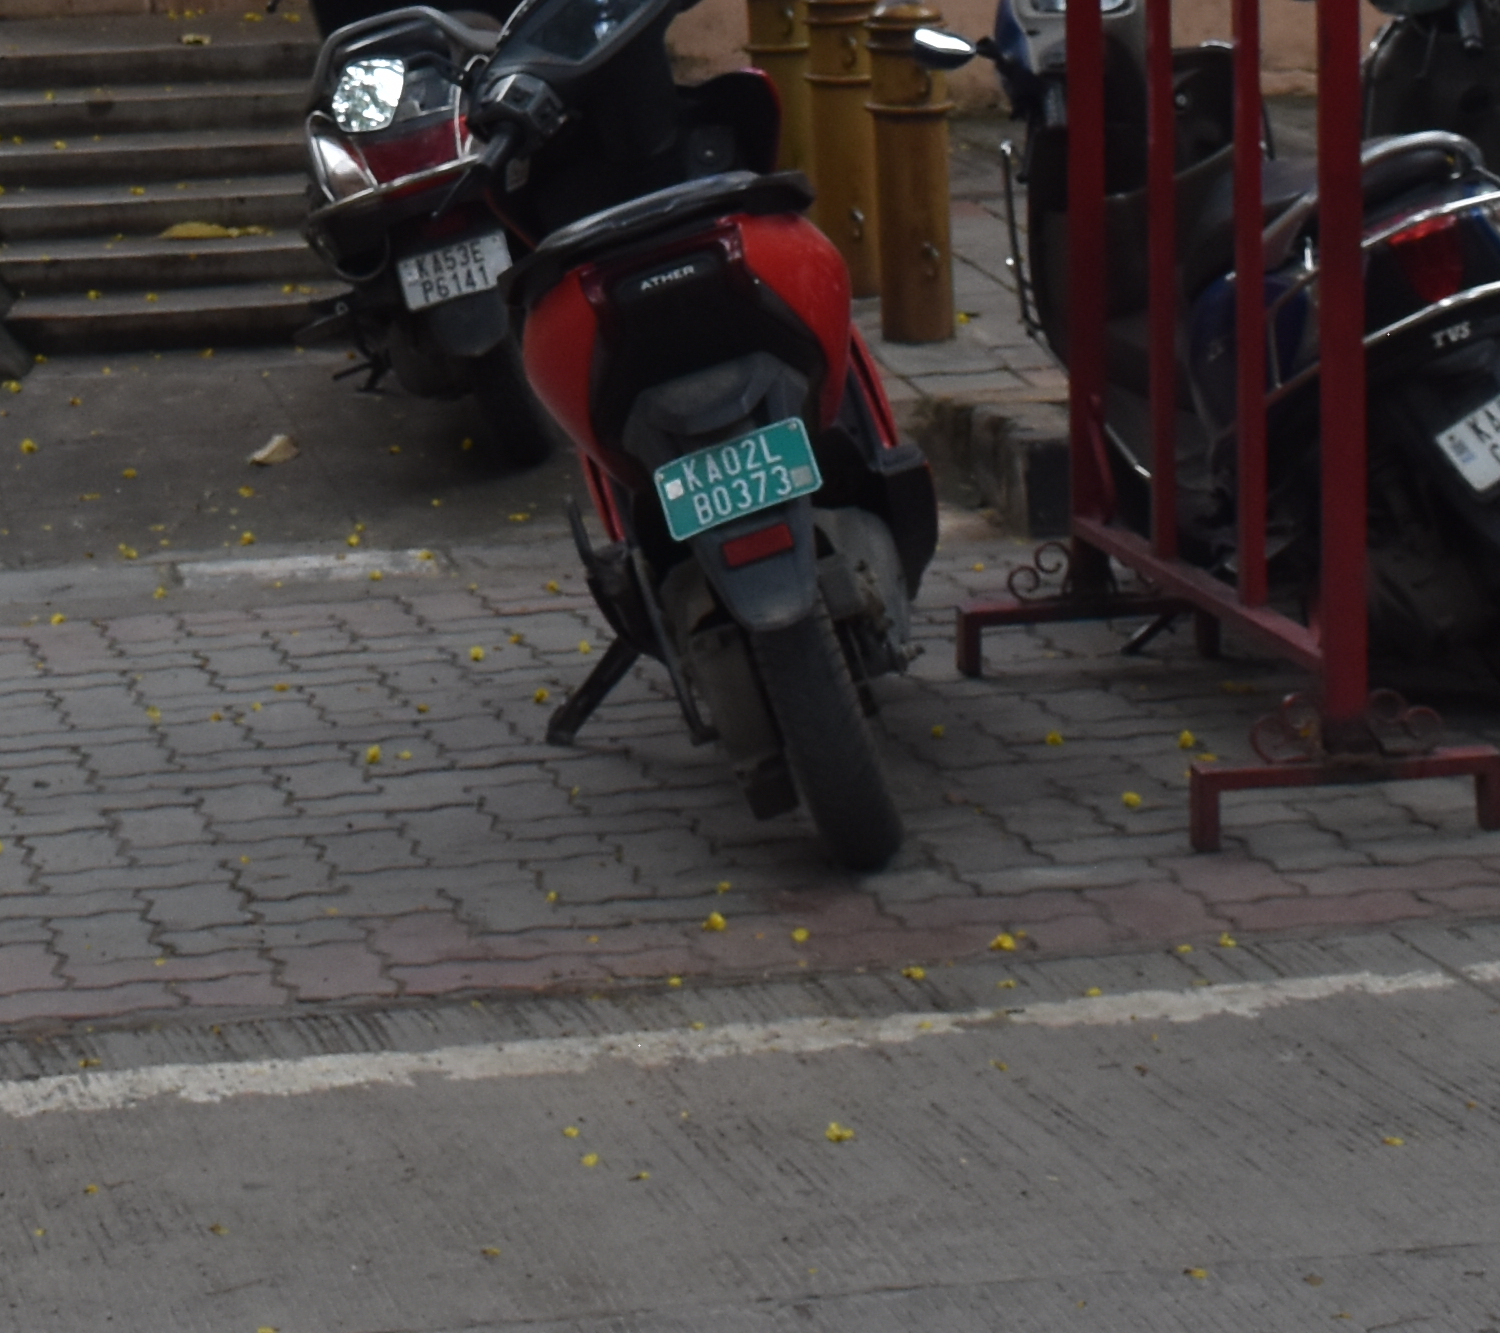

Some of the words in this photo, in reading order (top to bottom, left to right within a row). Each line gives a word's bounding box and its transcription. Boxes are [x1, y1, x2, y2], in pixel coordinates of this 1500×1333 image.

[415, 240, 485, 279] KA53E
[640, 264, 695, 291] ATHER
[421, 264, 490, 304] P6141
[1431, 320, 1472, 349] TVS
[681, 434, 784, 493] KA02L
[692, 464, 794, 526] B0373
